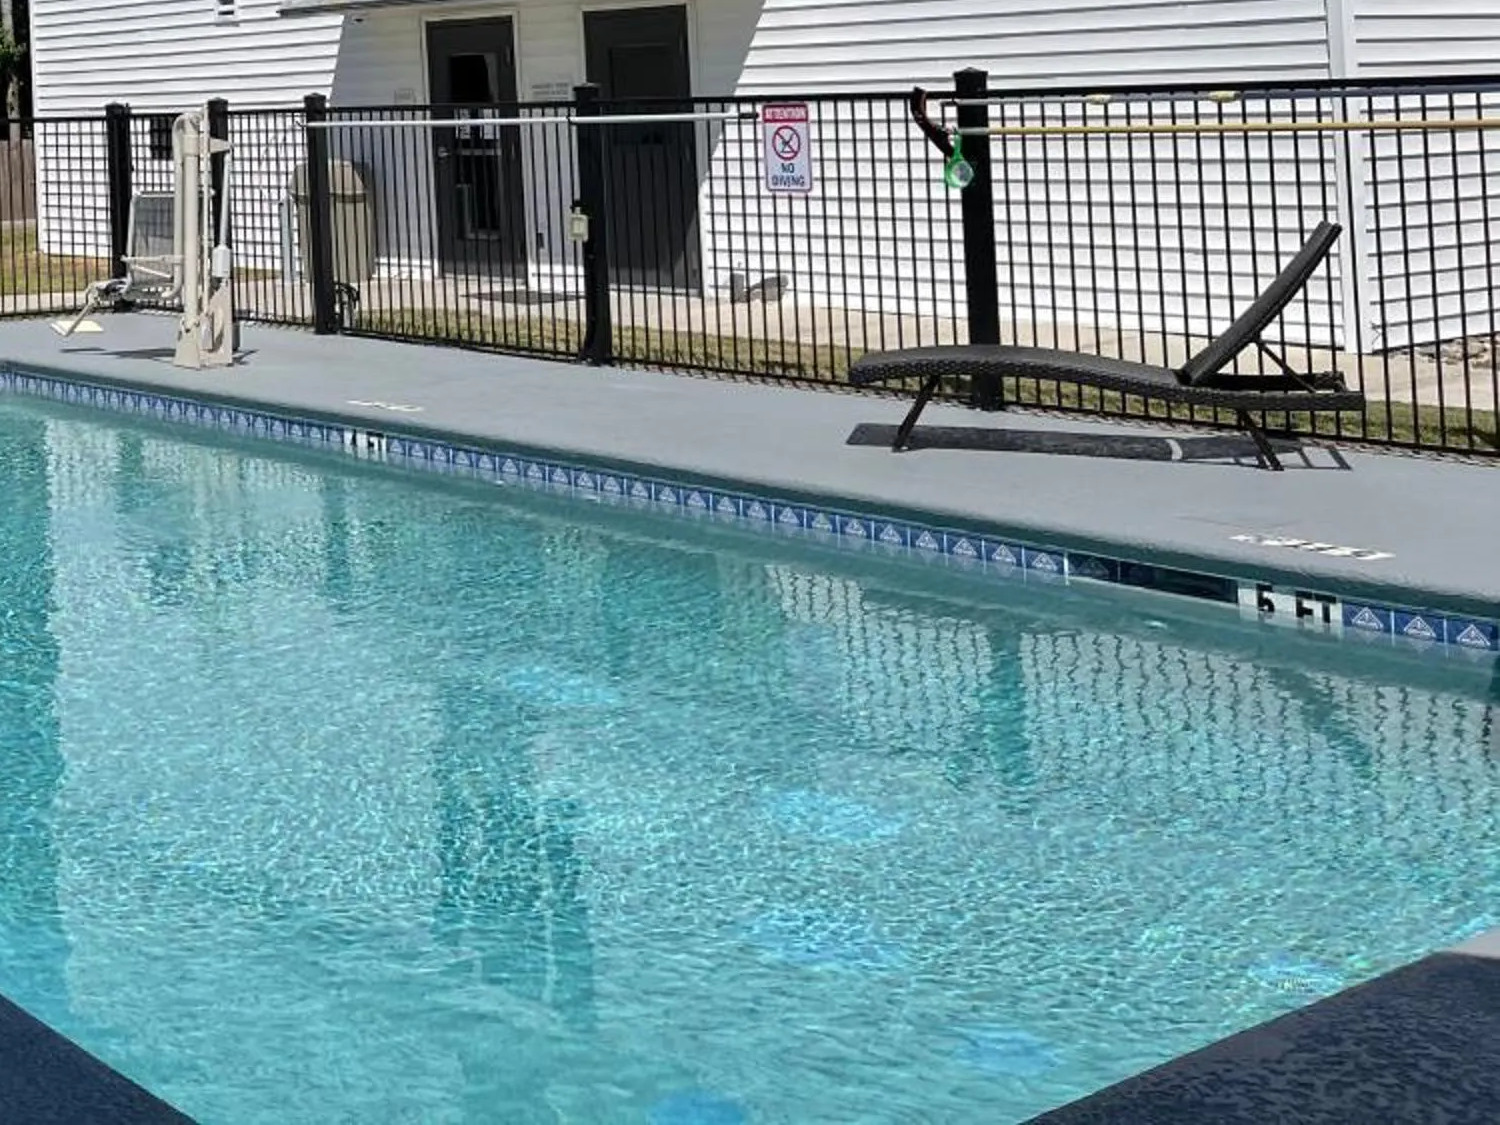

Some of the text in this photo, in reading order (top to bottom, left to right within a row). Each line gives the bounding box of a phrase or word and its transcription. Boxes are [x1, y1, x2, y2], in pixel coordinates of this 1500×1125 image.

[780, 162, 795, 174] NO
[771, 174, 806, 188] DIVING
[366, 430, 385, 452] FT
[1295, 590, 1337, 624] FT
